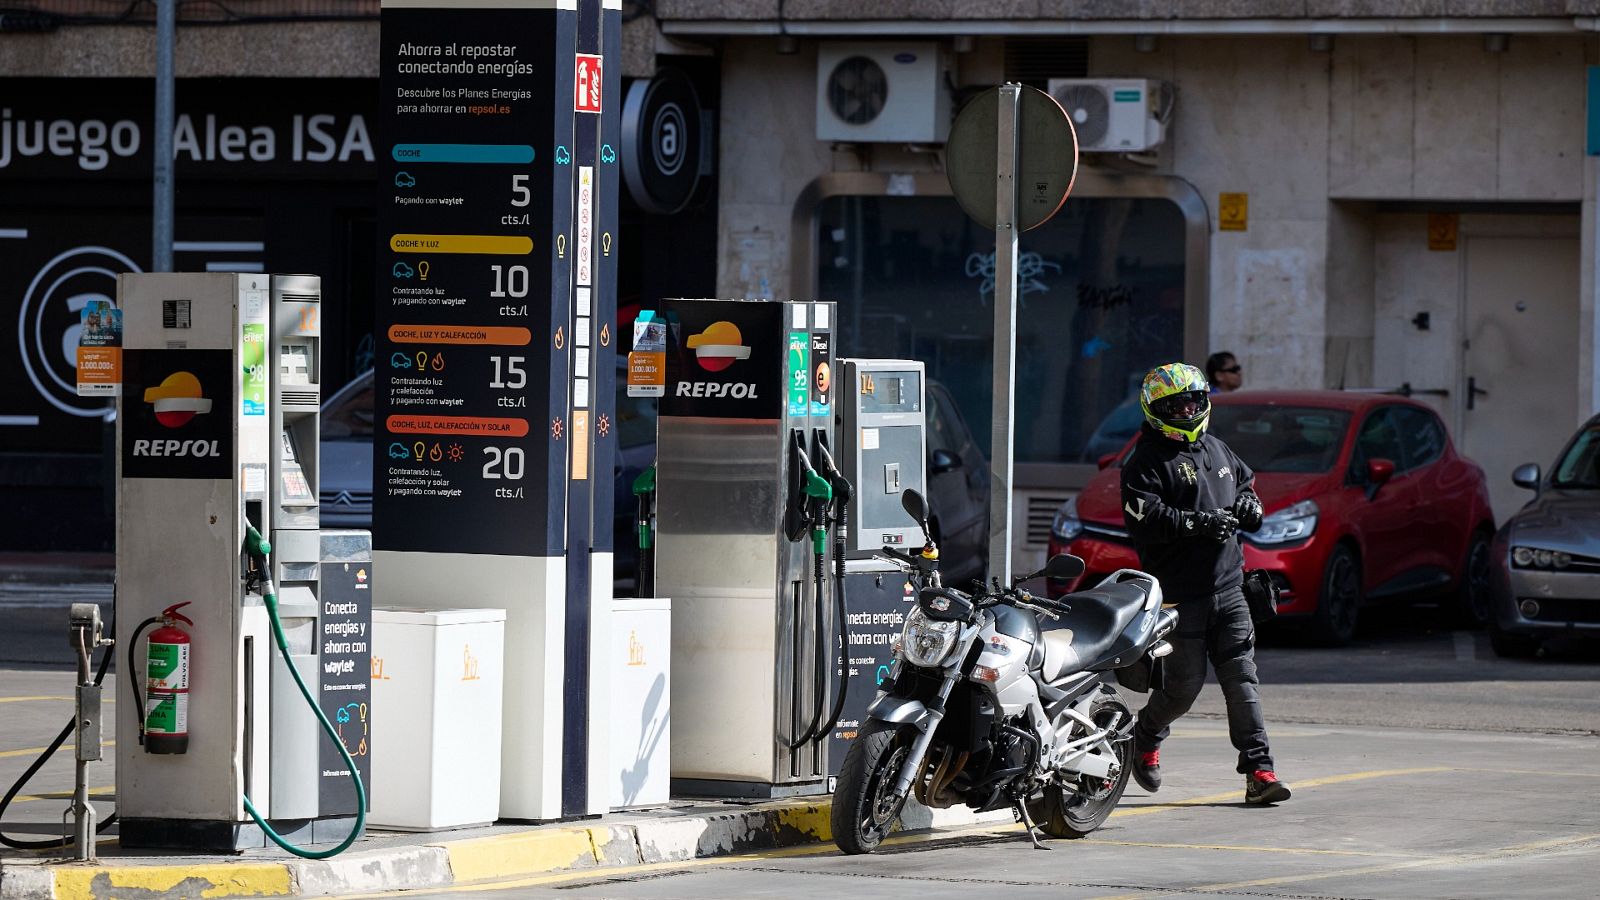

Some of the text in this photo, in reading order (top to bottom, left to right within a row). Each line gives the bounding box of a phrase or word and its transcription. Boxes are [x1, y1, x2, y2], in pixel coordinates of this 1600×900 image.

[398, 42, 516, 59] Ahorra al repostar
[398, 60, 533, 78] conectando energías
[397, 87, 532, 101] Descubre los Planes Energías
[397, 103, 511, 115] para ahorrar en repsol.es
[0, 107, 375, 171] juego Alea ISA
[662, 122, 677, 155] a
[510, 174, 531, 207] 5
[395, 196, 424, 206] Pagando
[501, 213, 530, 225] cts./l
[395, 240, 419, 248] COCHE
[490, 265, 529, 298] 10
[392, 287, 445, 295] Contratando luz
[392, 298, 397, 306] y
[397, 297, 427, 305] pagando
[499, 304, 528, 316] cts./l
[393, 331, 419, 339] COCHE,
[420, 331, 433, 339] LUZ
[440, 330, 487, 340] CALEFACCIÓN
[812, 340, 828, 350] Diesel
[249, 364, 264, 382] 98
[489, 356, 527, 389] 15
[794, 370, 807, 387] 95
[391, 377, 443, 386] Contratando luz
[860, 374, 875, 394] 14
[396, 387, 434, 395] calefacción
[676, 380, 759, 399] REPSOL
[396, 397, 425, 406] pagando
[497, 396, 526, 408] cts./l
[391, 421, 511, 432] COCHE, LUZ, CALEFACCIÓN Y SOLAR
[132, 438, 220, 458] REPSOL
[482, 446, 525, 480] 20
[388, 467, 442, 477] Contratando luz,
[388, 477, 450, 487] calefacción y solar
[388, 488, 393, 496] y
[393, 487, 423, 497] pagando
[495, 487, 524, 499] cts./l
[325, 601, 358, 615] Conecta
[872, 609, 904, 628] energías
[324, 619, 366, 637] energías y
[872, 633, 888, 645] con
[324, 640, 367, 654] ahorra con
[324, 659, 355, 676] waylet
